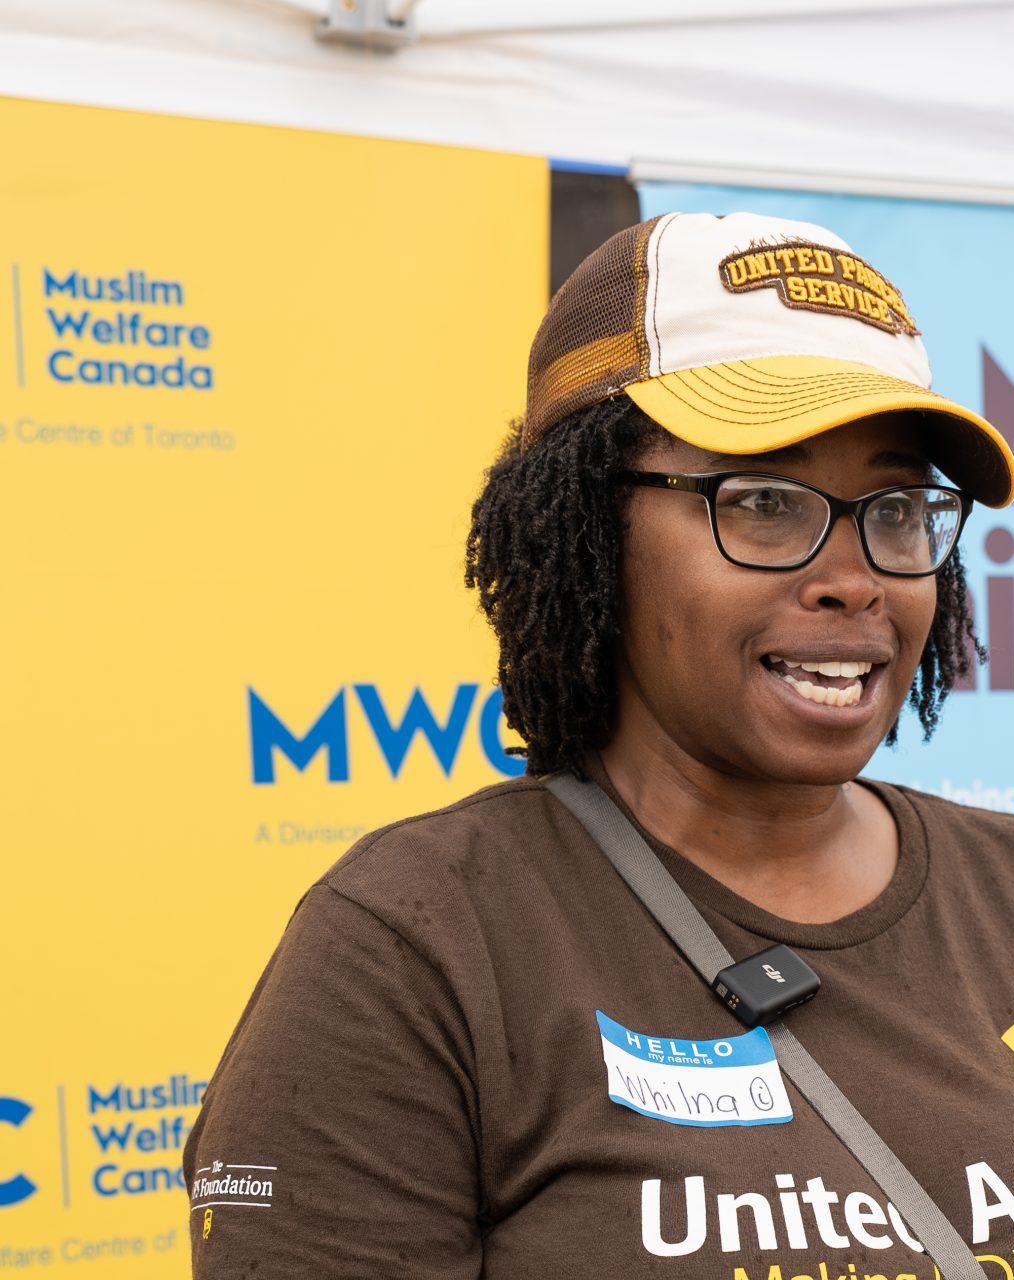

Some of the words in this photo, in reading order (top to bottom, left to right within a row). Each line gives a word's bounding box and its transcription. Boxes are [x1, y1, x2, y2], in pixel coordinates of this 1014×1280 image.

[727, 248, 834, 286] UNITED
[43, 267, 184, 306] Muslim
[786, 276, 893, 324] SERVICE
[47, 308, 211, 349] Welfare
[48, 350, 214, 390] Canada
[111, 422, 134, 448] of
[626, 1031, 733, 1058] HELLO
[648, 1052, 664, 1064] my
[667, 1053, 700, 1065] name
[703, 1055, 714, 1065] is
[91, 1116, 190, 1153] Welf
[212, 1160, 223, 1173] The
[200, 1174, 273, 1197] Foundation
